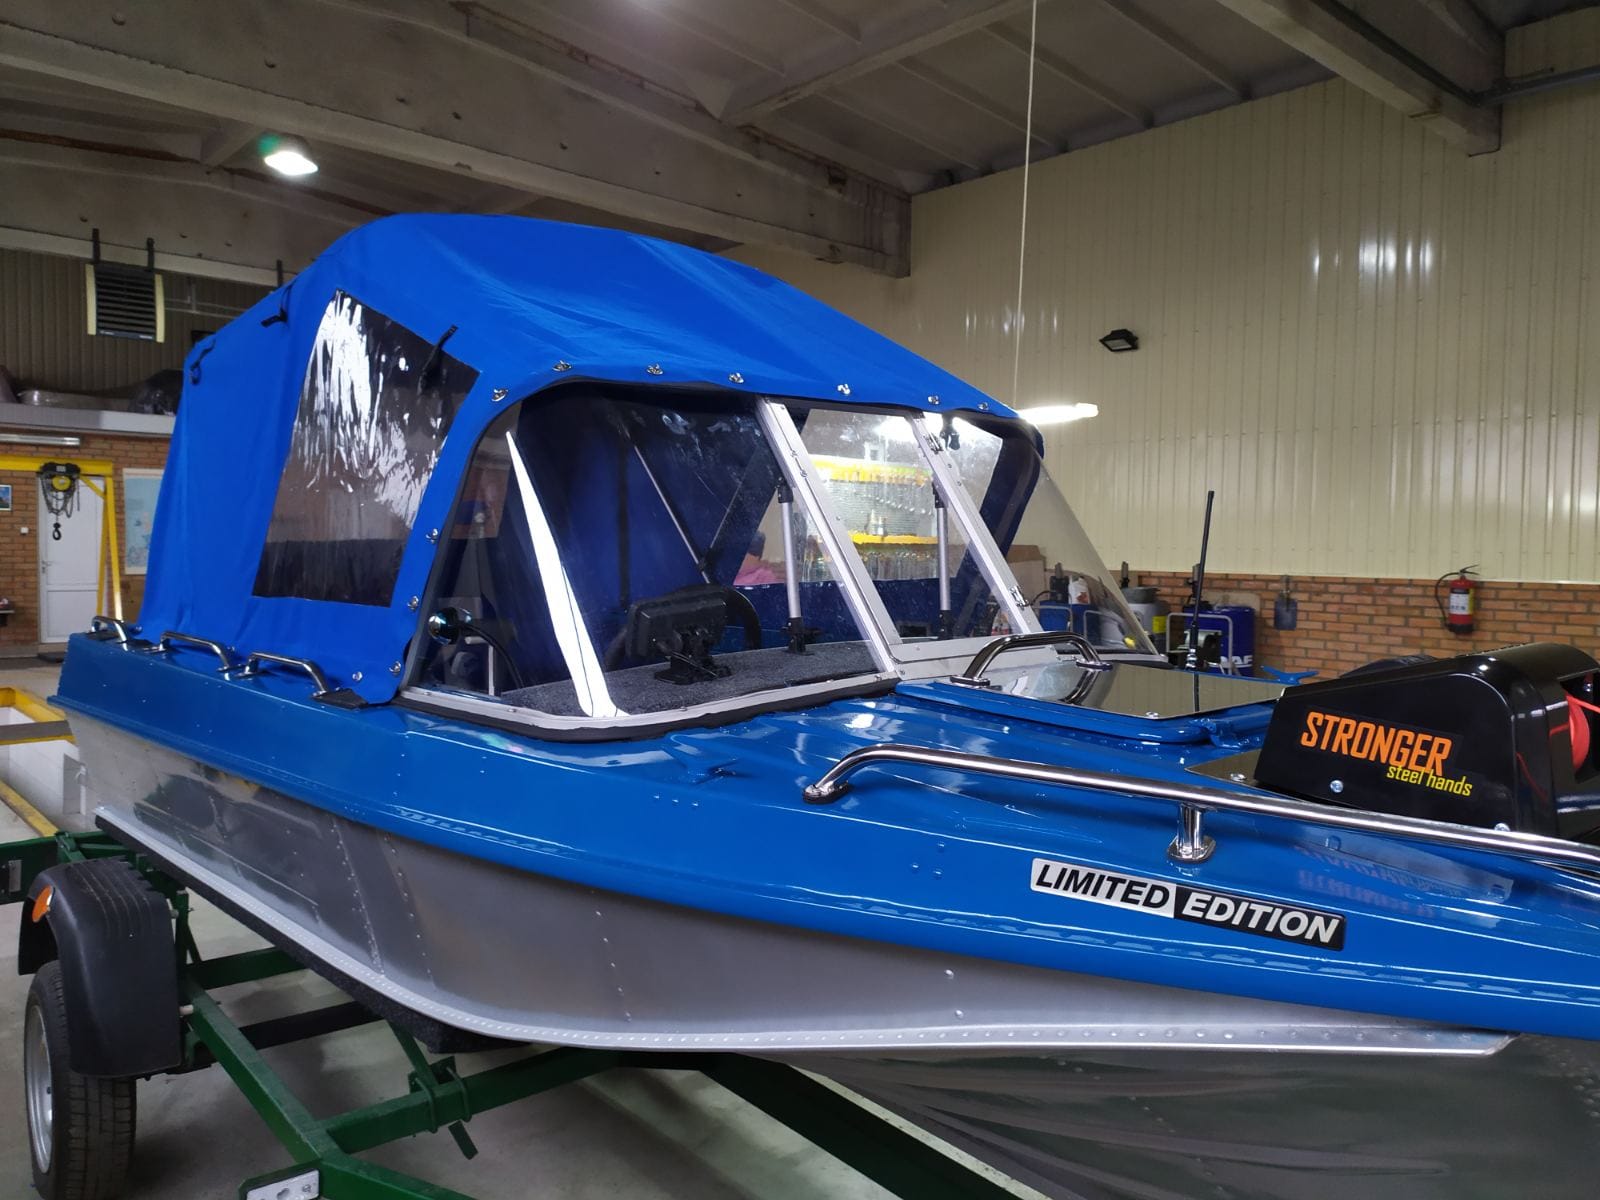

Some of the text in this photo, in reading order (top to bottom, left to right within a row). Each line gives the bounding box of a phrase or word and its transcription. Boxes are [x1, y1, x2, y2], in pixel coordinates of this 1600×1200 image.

[1301, 711, 1452, 777] STRONGER
[1387, 766, 1472, 796] steel hands
[1036, 864, 1170, 910] LIMITED
[1182, 891, 1340, 943] EDITION
